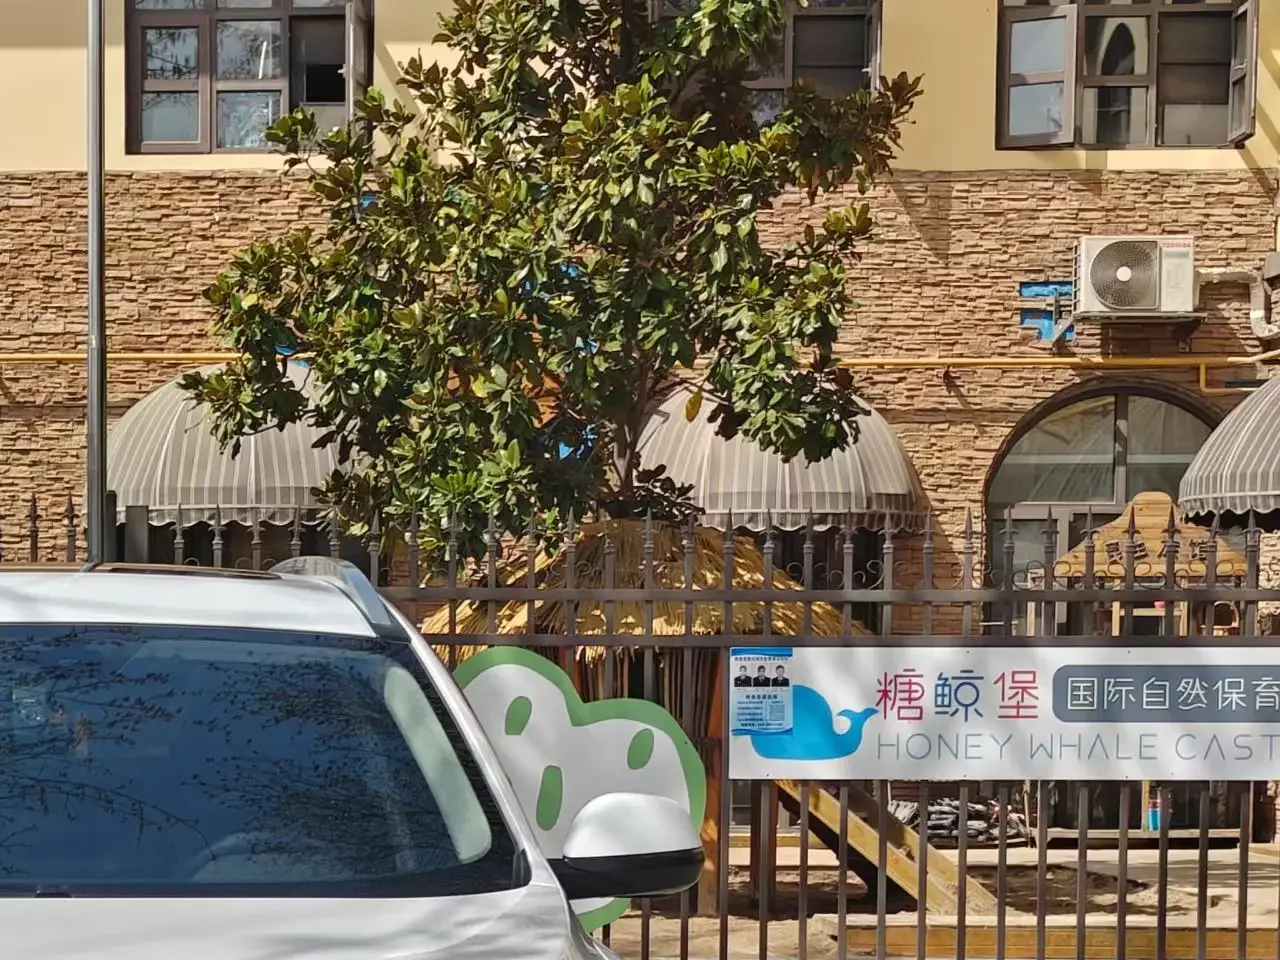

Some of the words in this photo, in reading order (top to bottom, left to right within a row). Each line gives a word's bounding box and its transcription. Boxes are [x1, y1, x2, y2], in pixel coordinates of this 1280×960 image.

[876, 669, 1039, 722] 糖鲸堡
[1067, 676, 1280, 711] 国际自然保育
[877, 732, 1013, 760] HONEY
[1030, 732, 1158, 760] WHALE
[1175, 732, 1280, 761] CAST
